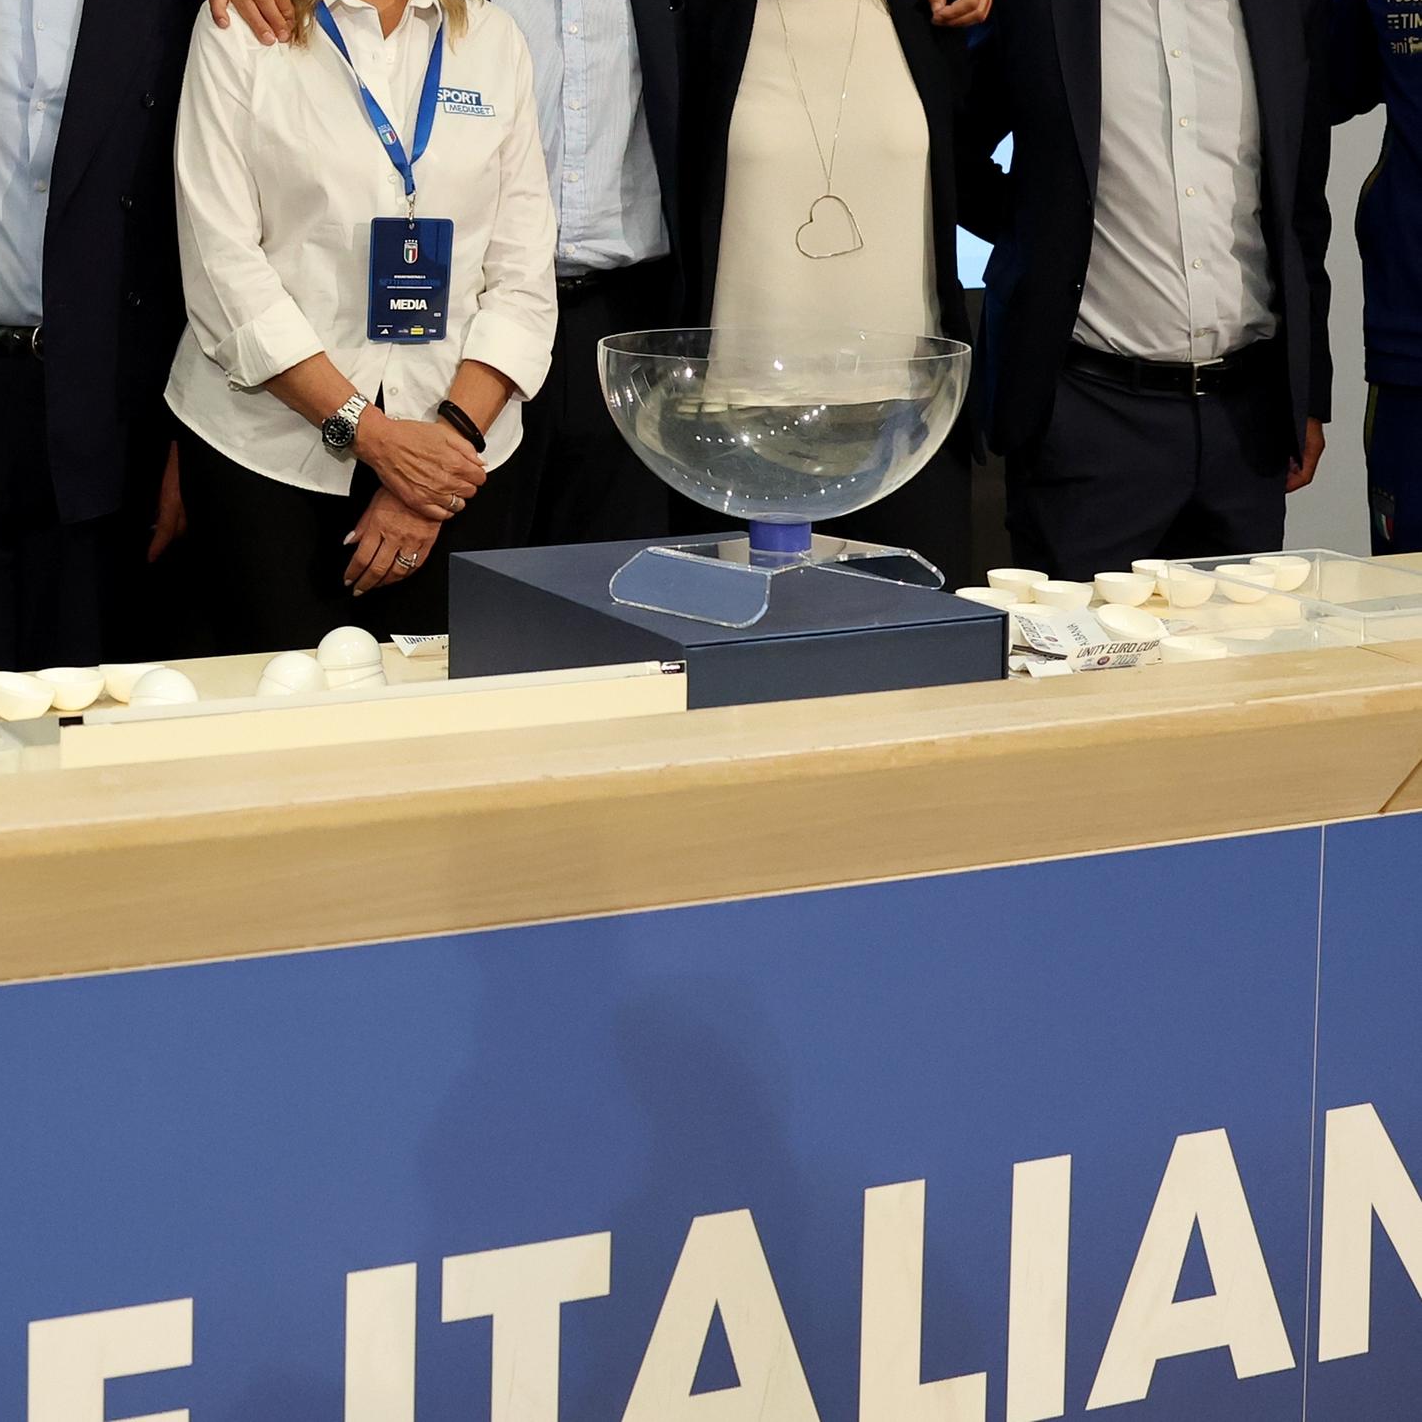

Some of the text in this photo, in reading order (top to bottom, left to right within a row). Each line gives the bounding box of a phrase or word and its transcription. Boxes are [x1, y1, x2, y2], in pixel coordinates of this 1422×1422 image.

[437, 89, 479, 105] SPORT
[389, 299, 428, 310] MEDIA
[1076, 639, 1160, 659] UNITY EURO CUP
